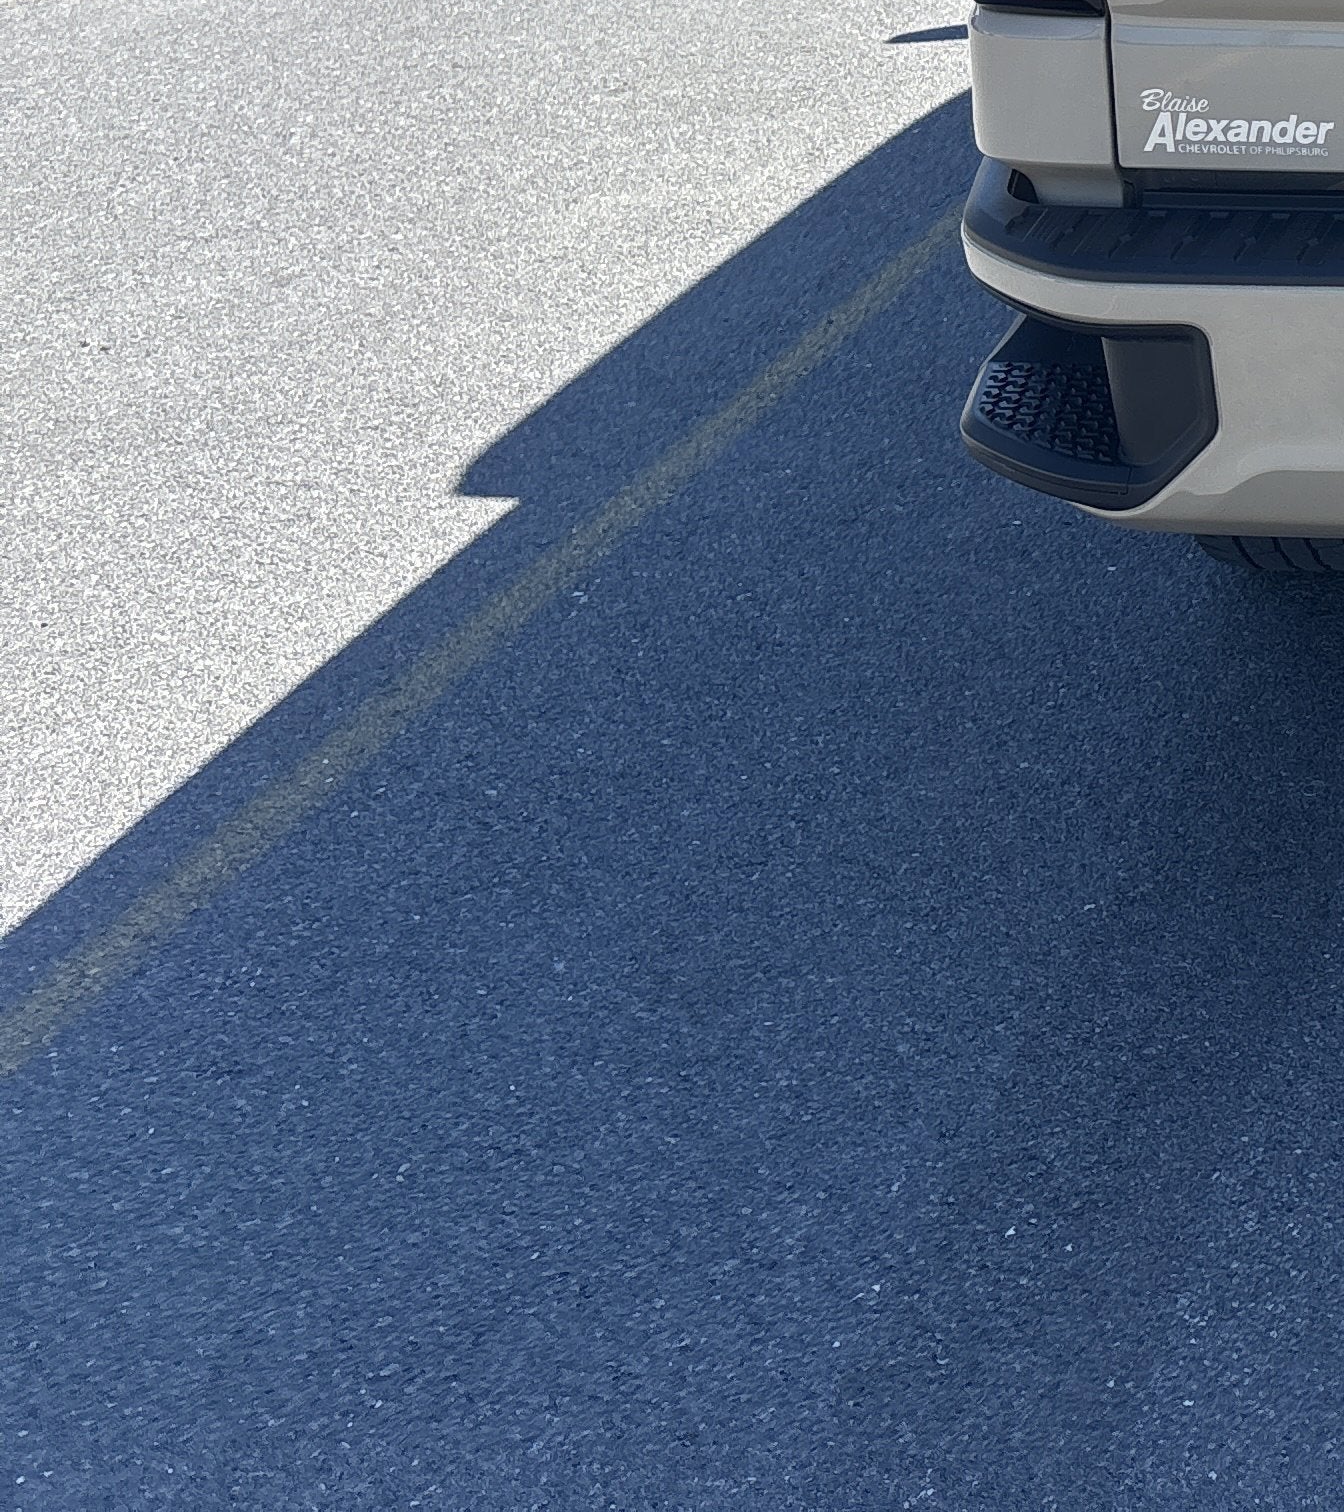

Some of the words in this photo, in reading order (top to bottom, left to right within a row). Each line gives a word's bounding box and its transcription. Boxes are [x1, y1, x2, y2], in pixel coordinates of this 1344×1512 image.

[1140, 88, 1210, 113] Blaise
[1143, 111, 1335, 153] Alexander
[1178, 143, 1247, 155] CHEVROLET
[1249, 144, 1264, 155] OF
